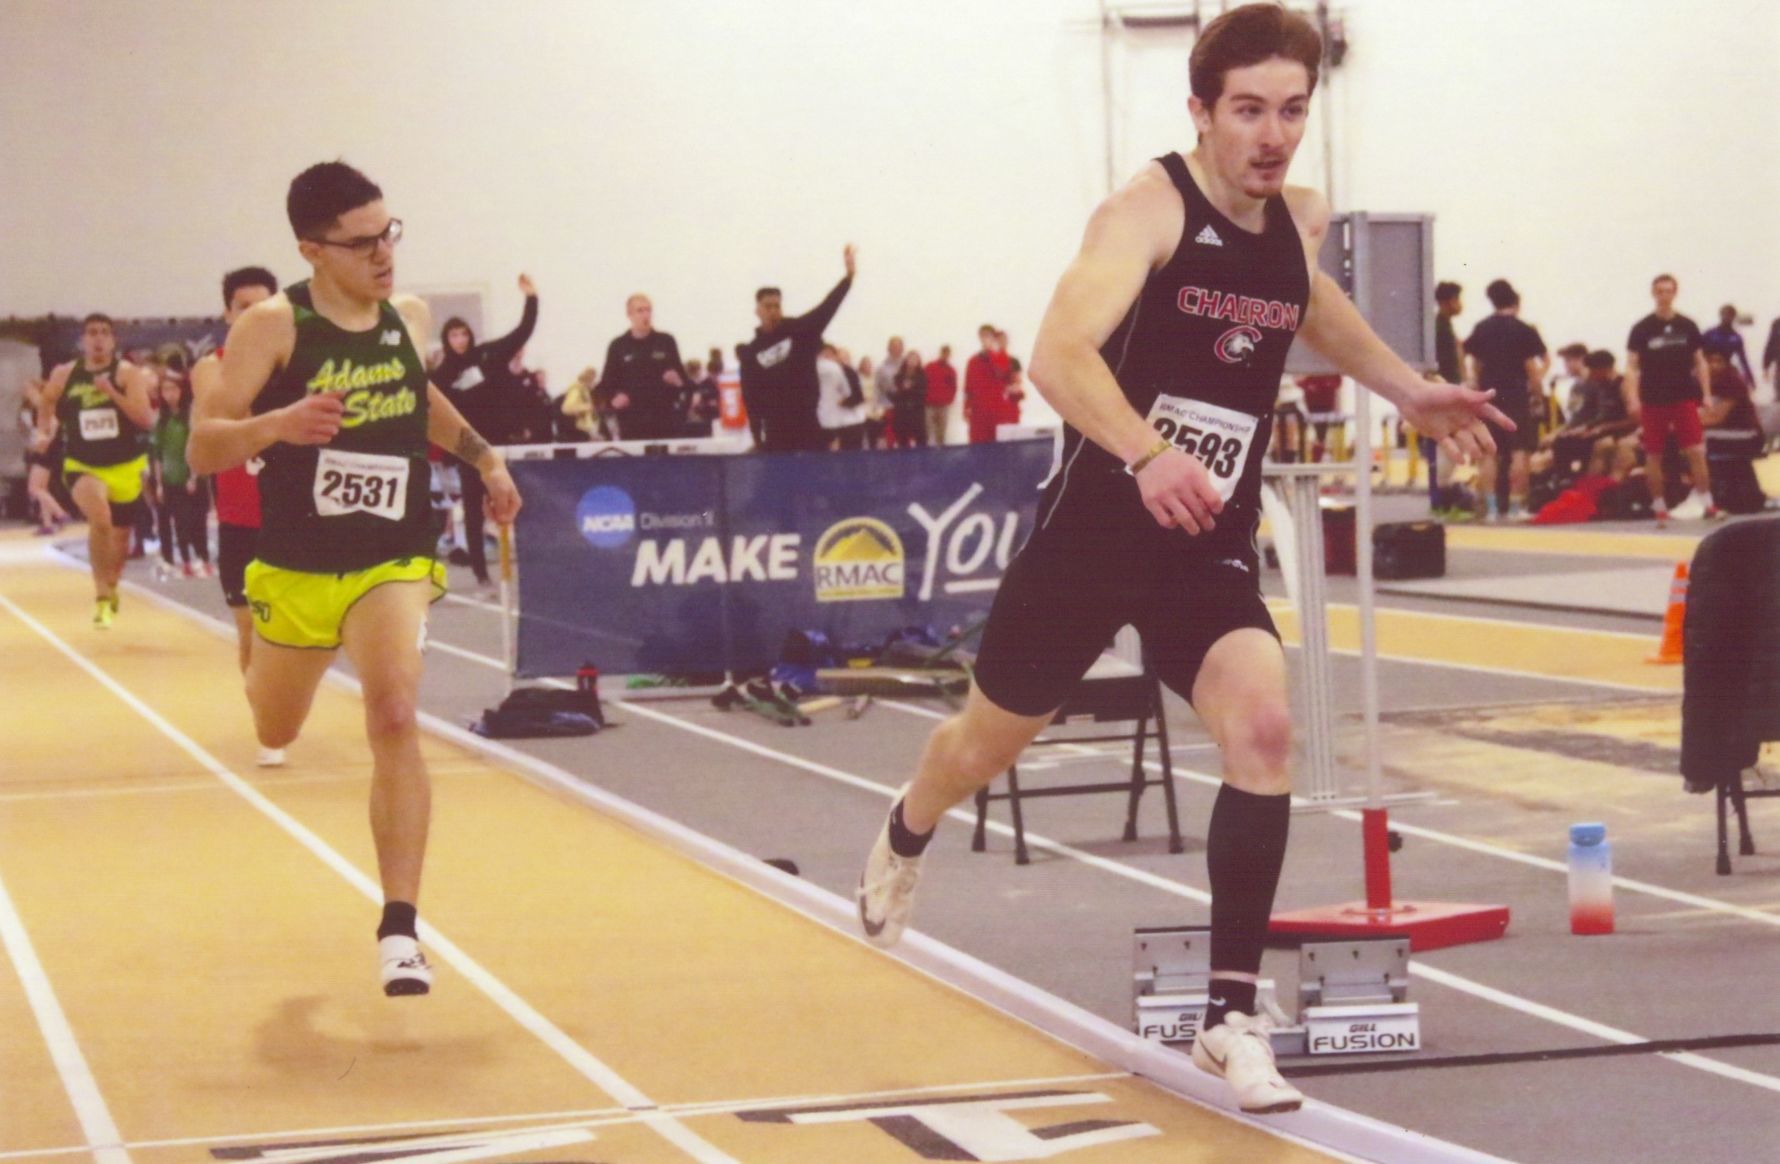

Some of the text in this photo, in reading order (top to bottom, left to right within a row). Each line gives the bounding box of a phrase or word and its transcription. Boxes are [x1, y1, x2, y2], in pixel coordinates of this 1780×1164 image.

[1177, 286, 1300, 331] CHADRON
[306, 356, 406, 391] Adams
[341, 386, 416, 429] State
[1153, 417, 1243, 479] 2593
[321, 470, 398, 508] 2531
[631, 533, 802, 587] MAKE
[815, 563, 901, 589] RMAC
[1143, 1023, 1196, 1039] FUS
[1313, 1033, 1415, 1051] FUSION
